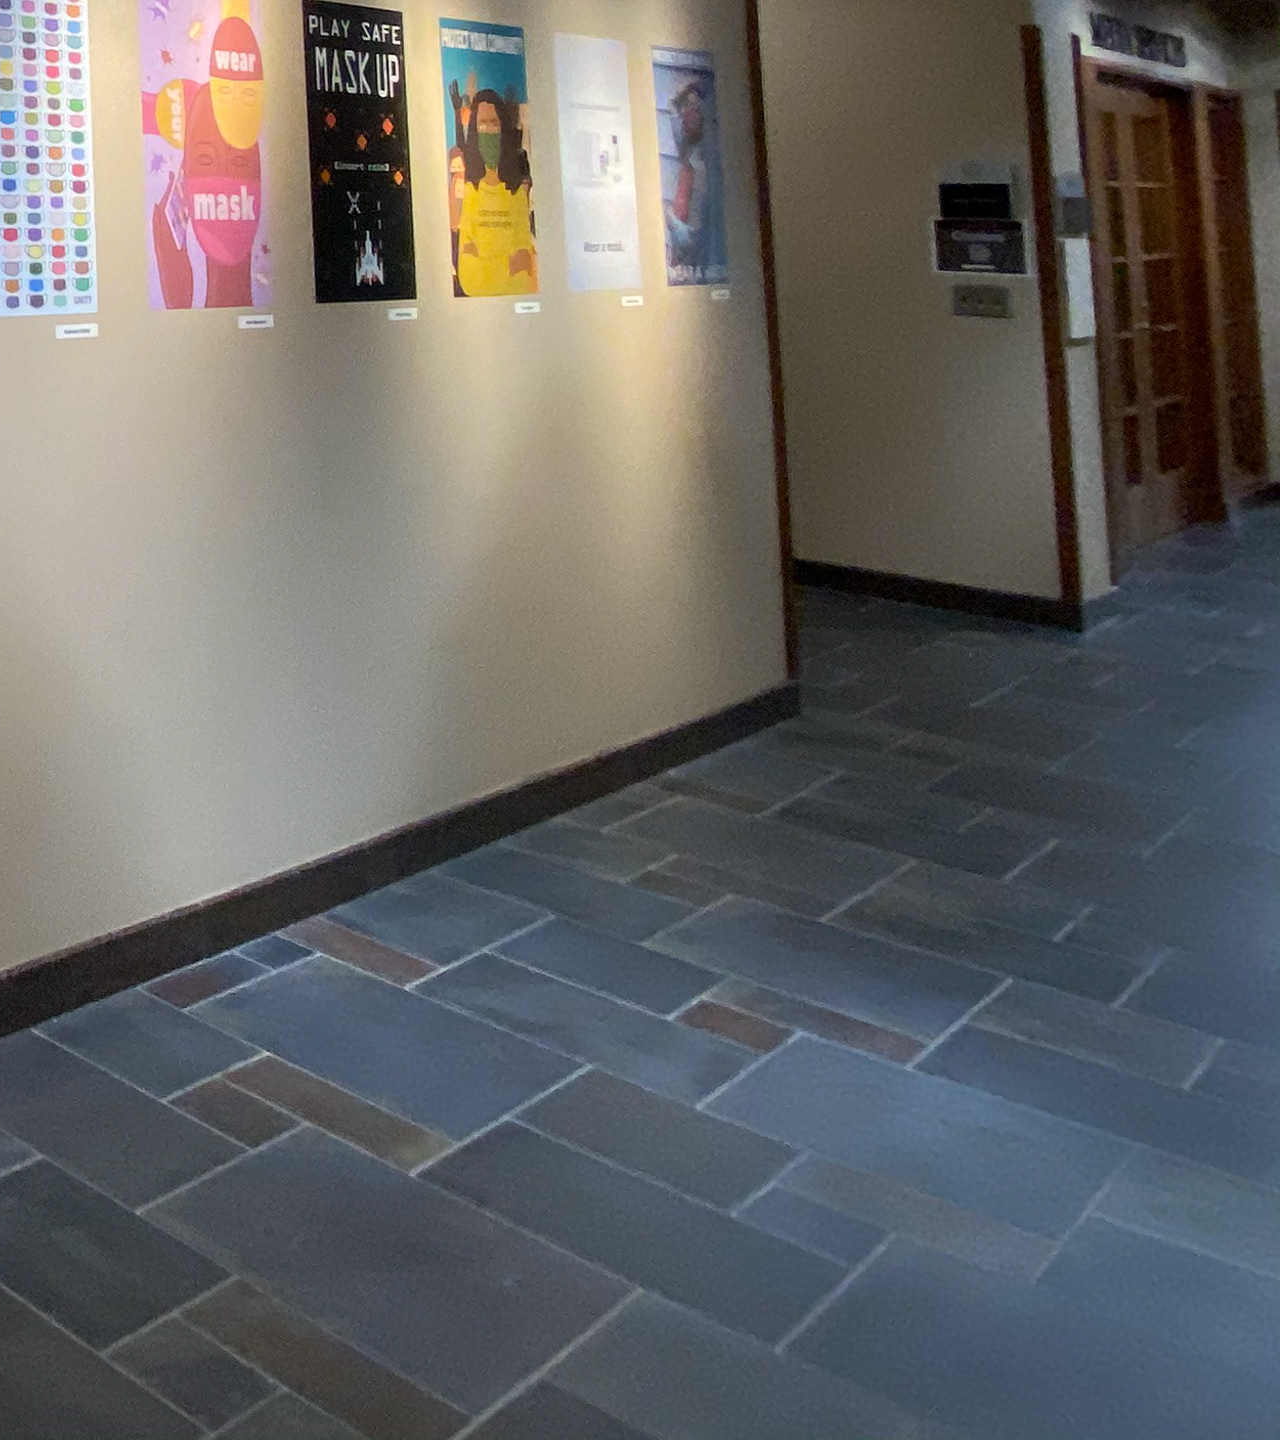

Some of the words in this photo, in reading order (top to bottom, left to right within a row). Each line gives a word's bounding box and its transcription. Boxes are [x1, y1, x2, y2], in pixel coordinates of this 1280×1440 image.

[308, 14, 350, 38] PLAY
[362, 21, 401, 45] SAFE
[214, 50, 256, 72] wear
[315, 46, 372, 95] MASK
[376, 53, 400, 98] UP
[193, 185, 256, 221] mask
